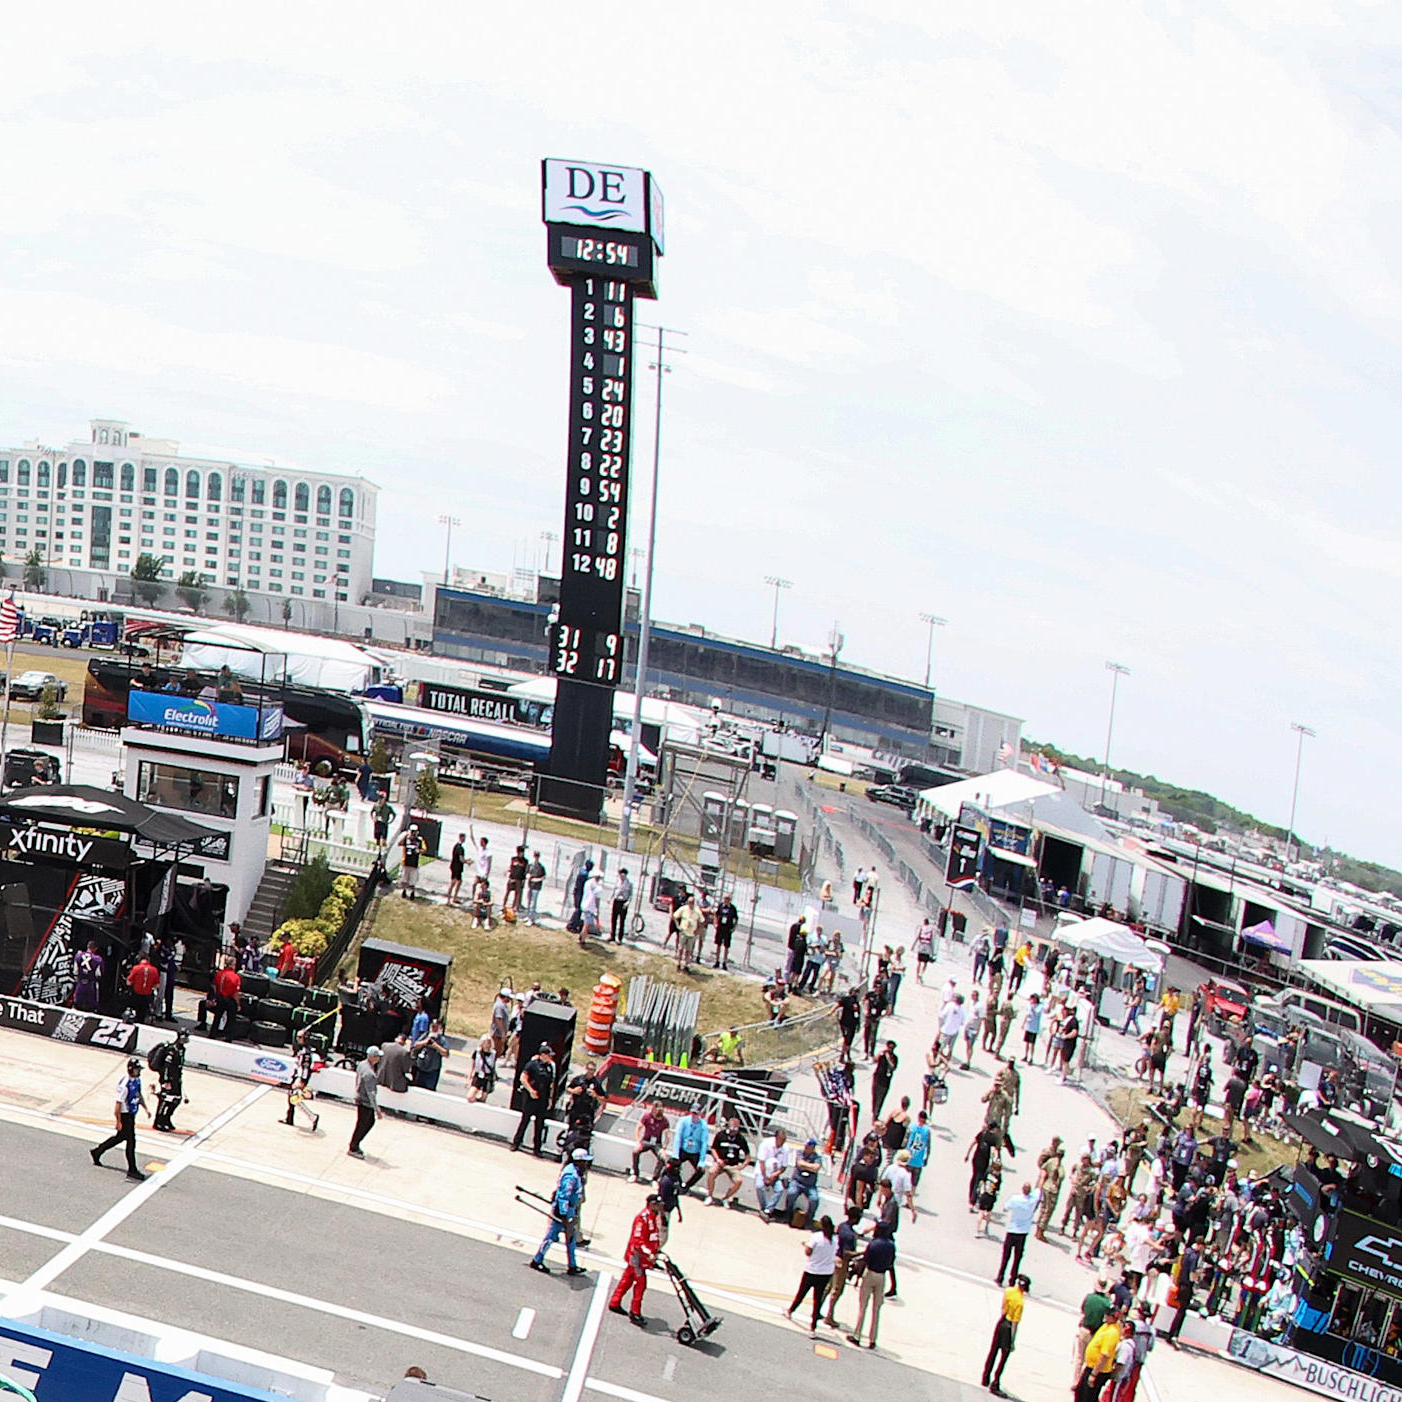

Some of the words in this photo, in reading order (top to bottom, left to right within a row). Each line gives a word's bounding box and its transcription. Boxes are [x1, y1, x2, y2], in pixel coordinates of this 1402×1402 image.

[565, 167, 626, 204] DE
[576, 238, 629, 266] 12:54
[585, 279, 594, 295] 1
[608, 281, 626, 302] 11
[583, 302, 595, 320] 2
[613, 305, 626, 328] 6
[583, 327, 595, 345] 3
[603, 329, 626, 353] 43
[583, 352, 595, 370] 4
[617, 356, 626, 377] 1
[582, 377, 594, 395] 5
[601, 378, 625, 402] 24
[582, 402, 593, 420] 6
[600, 403, 624, 428] 20
[581, 427, 593, 445] 7
[599, 428, 624, 454] 23
[580, 452, 592, 470] 8
[598, 454, 623, 479] 22
[579, 477, 591, 496] 9
[598, 479, 621, 504] 54
[574, 502, 594, 522] 10
[607, 506, 620, 530] 2
[573, 528, 592, 548] 11
[606, 532, 619, 555] 8
[572, 554, 592, 573] 12
[594, 556, 618, 581] 48
[557, 625, 581, 649] 31
[606, 634, 618, 656] 9
[555, 649, 579, 675] 32
[597, 658, 616, 680] 17
[429, 690, 467, 712] TOTAL
[470, 698, 517, 722] RECALL
[429, 728, 468, 745] NASCAR
[8, 825, 95, 863] xfinity
[7, 1002, 46, 1025] That
[90, 1019, 134, 1049] 23
[258, 1057, 283, 1072] Ford
[1347, 1259, 1402, 1290] CHEVR
